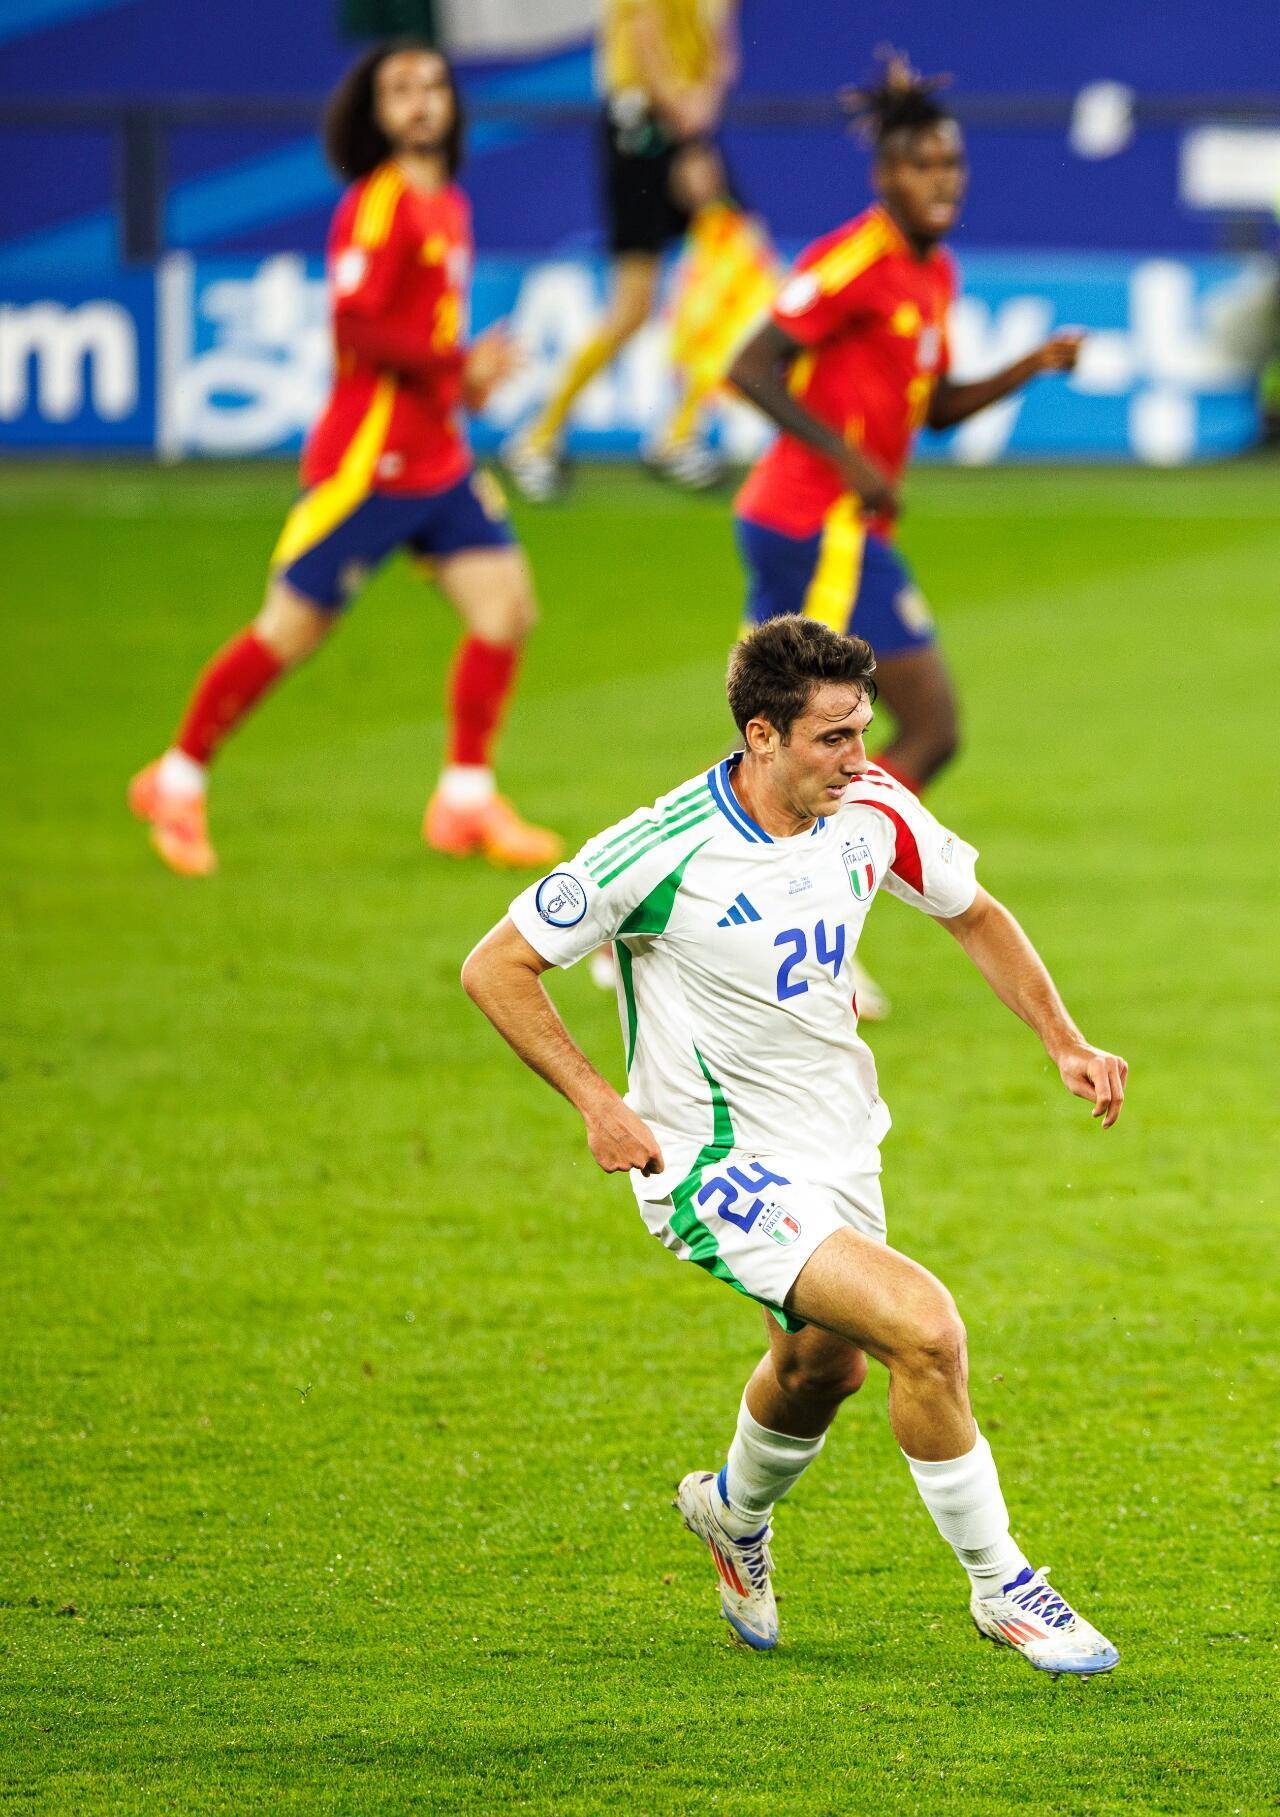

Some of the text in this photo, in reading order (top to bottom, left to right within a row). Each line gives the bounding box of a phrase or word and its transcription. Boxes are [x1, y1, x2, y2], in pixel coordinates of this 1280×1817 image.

[844, 849, 869, 866] ITALIA
[773, 918, 846, 1001] 24
[697, 1161, 792, 1234] 24
[764, 1210, 783, 1233] ITALIA
